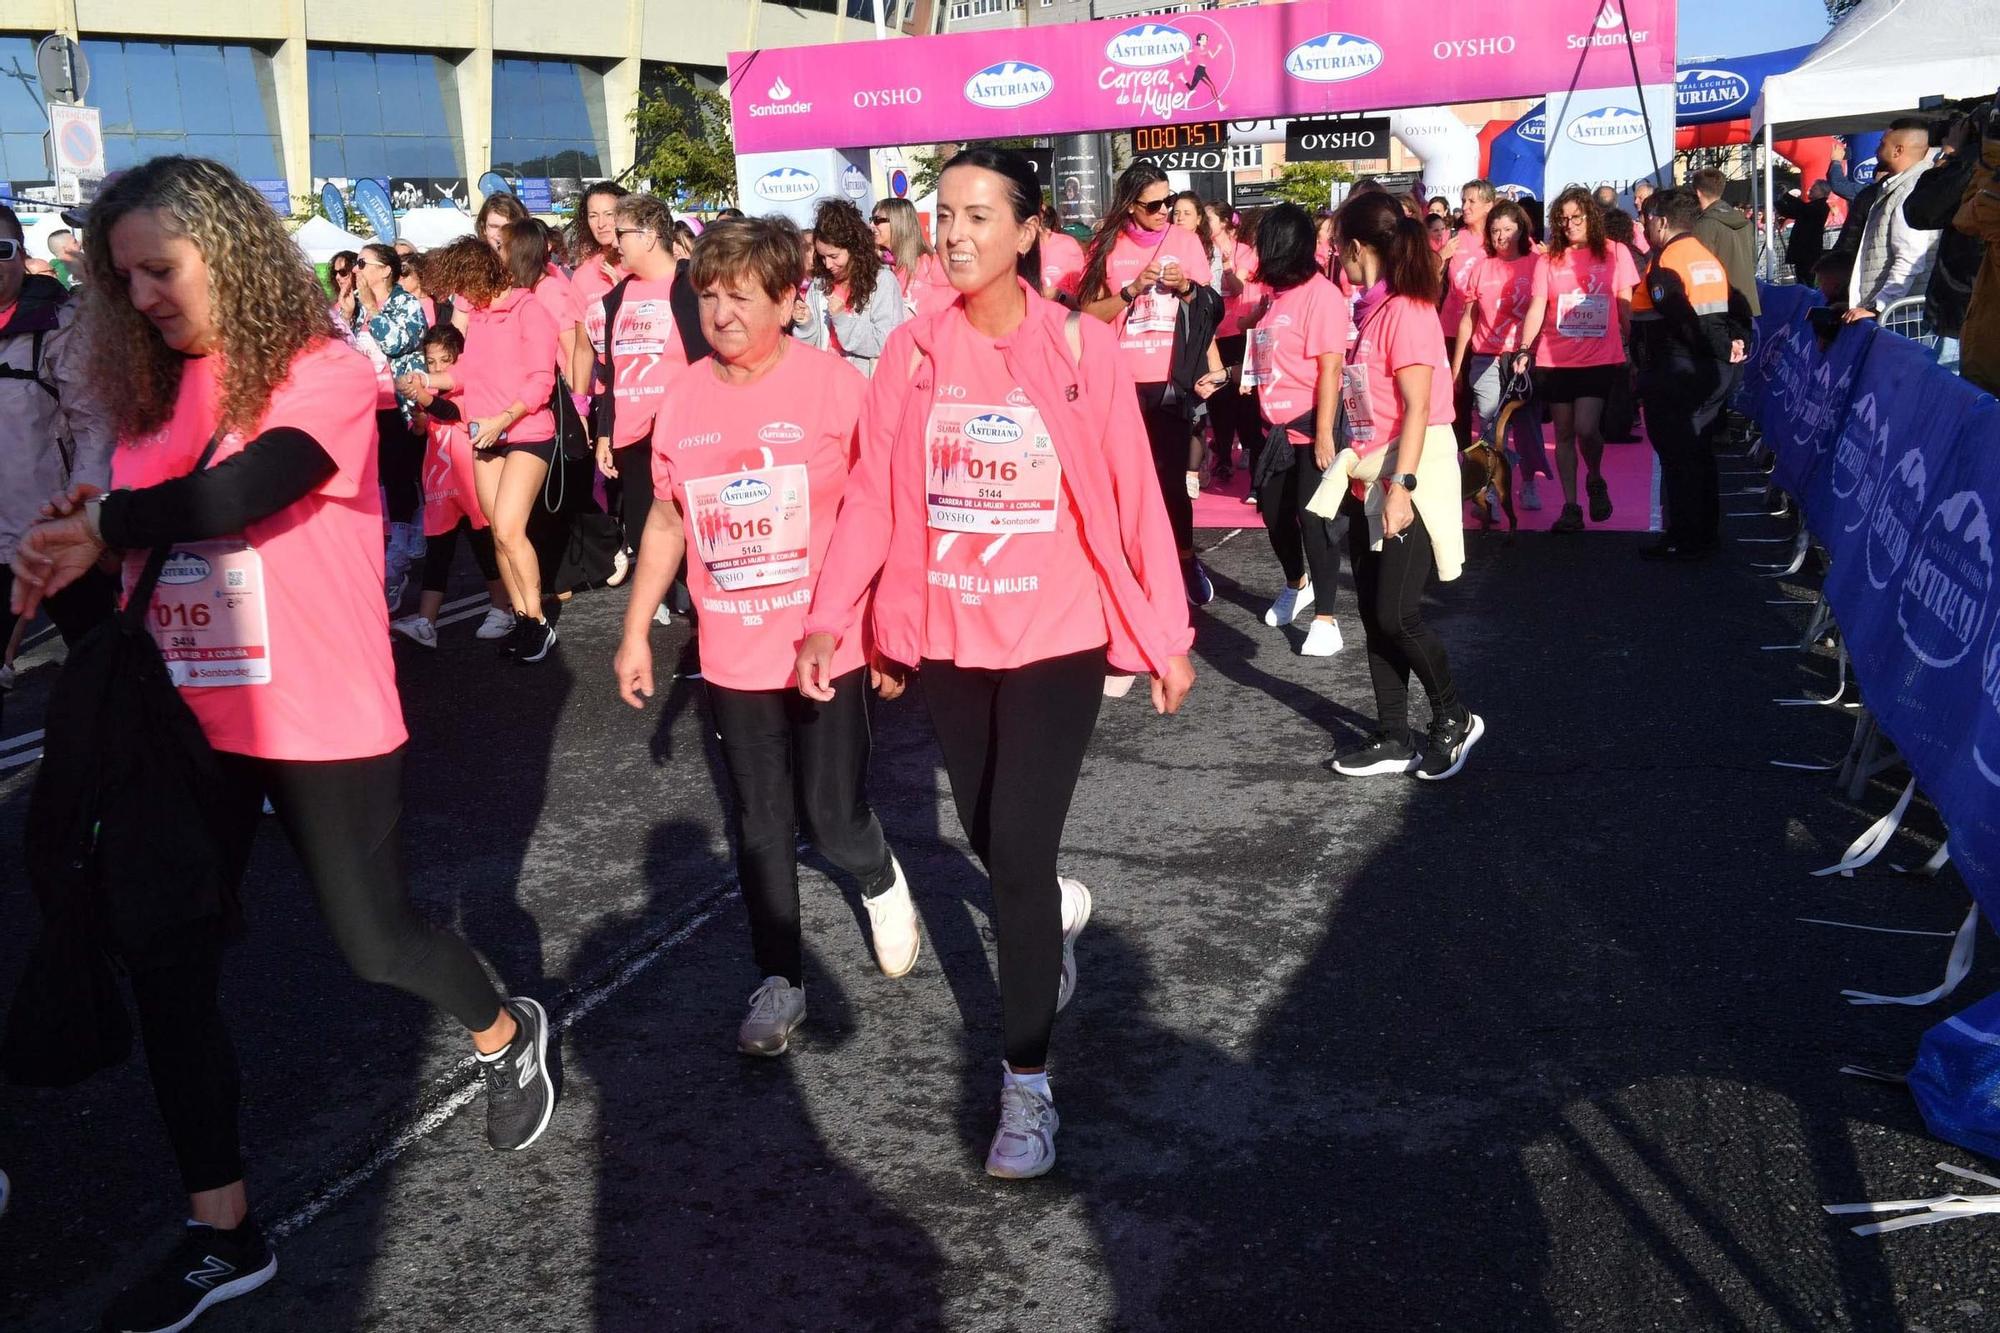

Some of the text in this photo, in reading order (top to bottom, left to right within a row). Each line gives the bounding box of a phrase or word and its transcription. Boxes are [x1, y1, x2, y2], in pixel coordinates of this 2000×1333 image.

[1567, 28, 1648, 49] Santander
[1113, 40, 1185, 58] ASTURIANA
[1433, 35, 1516, 60] OYSHO
[1292, 51, 1375, 73] ASTURIANA
[1098, 66, 1170, 90] Carrera
[853, 87, 922, 108] OYSHO
[971, 80, 1047, 99] ASTURIANA
[1677, 87, 1741, 105] URIANA
[749, 101, 813, 117] Santander
[1116, 88, 1196, 119] de la Mujer
[1137, 123, 1220, 151] 00:07:57
[1573, 122, 1645, 138] ASTURIANA
[1300, 130, 1375, 150] OYSHO
[759, 181, 816, 195] ASTURIANA
[1344, 398, 1357, 411] 16
[937, 425, 961, 434] SUMA
[968, 423, 1019, 439] ASTURIANA
[678, 432, 722, 449] OYSHO
[967, 459, 1018, 482] 016
[724, 487, 768, 503] ASTURIANA
[978, 488, 1002, 499] 5144
[938, 496, 964, 507] CARRERA
[964, 499, 973, 508] DE
[974, 500, 982, 509] LA
[936, 510, 975, 524] OYSHO
[1001, 517, 1041, 526] Santander
[729, 517, 773, 541] 016
[741, 545, 762, 556] 5143
[161, 565, 207, 578] STURIANA
[712, 560, 733, 570] CARRERA
[732, 558, 740, 567] DE
[740, 557, 748, 566] LA
[927, 570, 1039, 595] RRERA DE LA MUJER
[702, 589, 811, 615] CARRERA DE LA MUJER
[157, 602, 212, 628] 016
[199, 663, 251, 678] Santander
